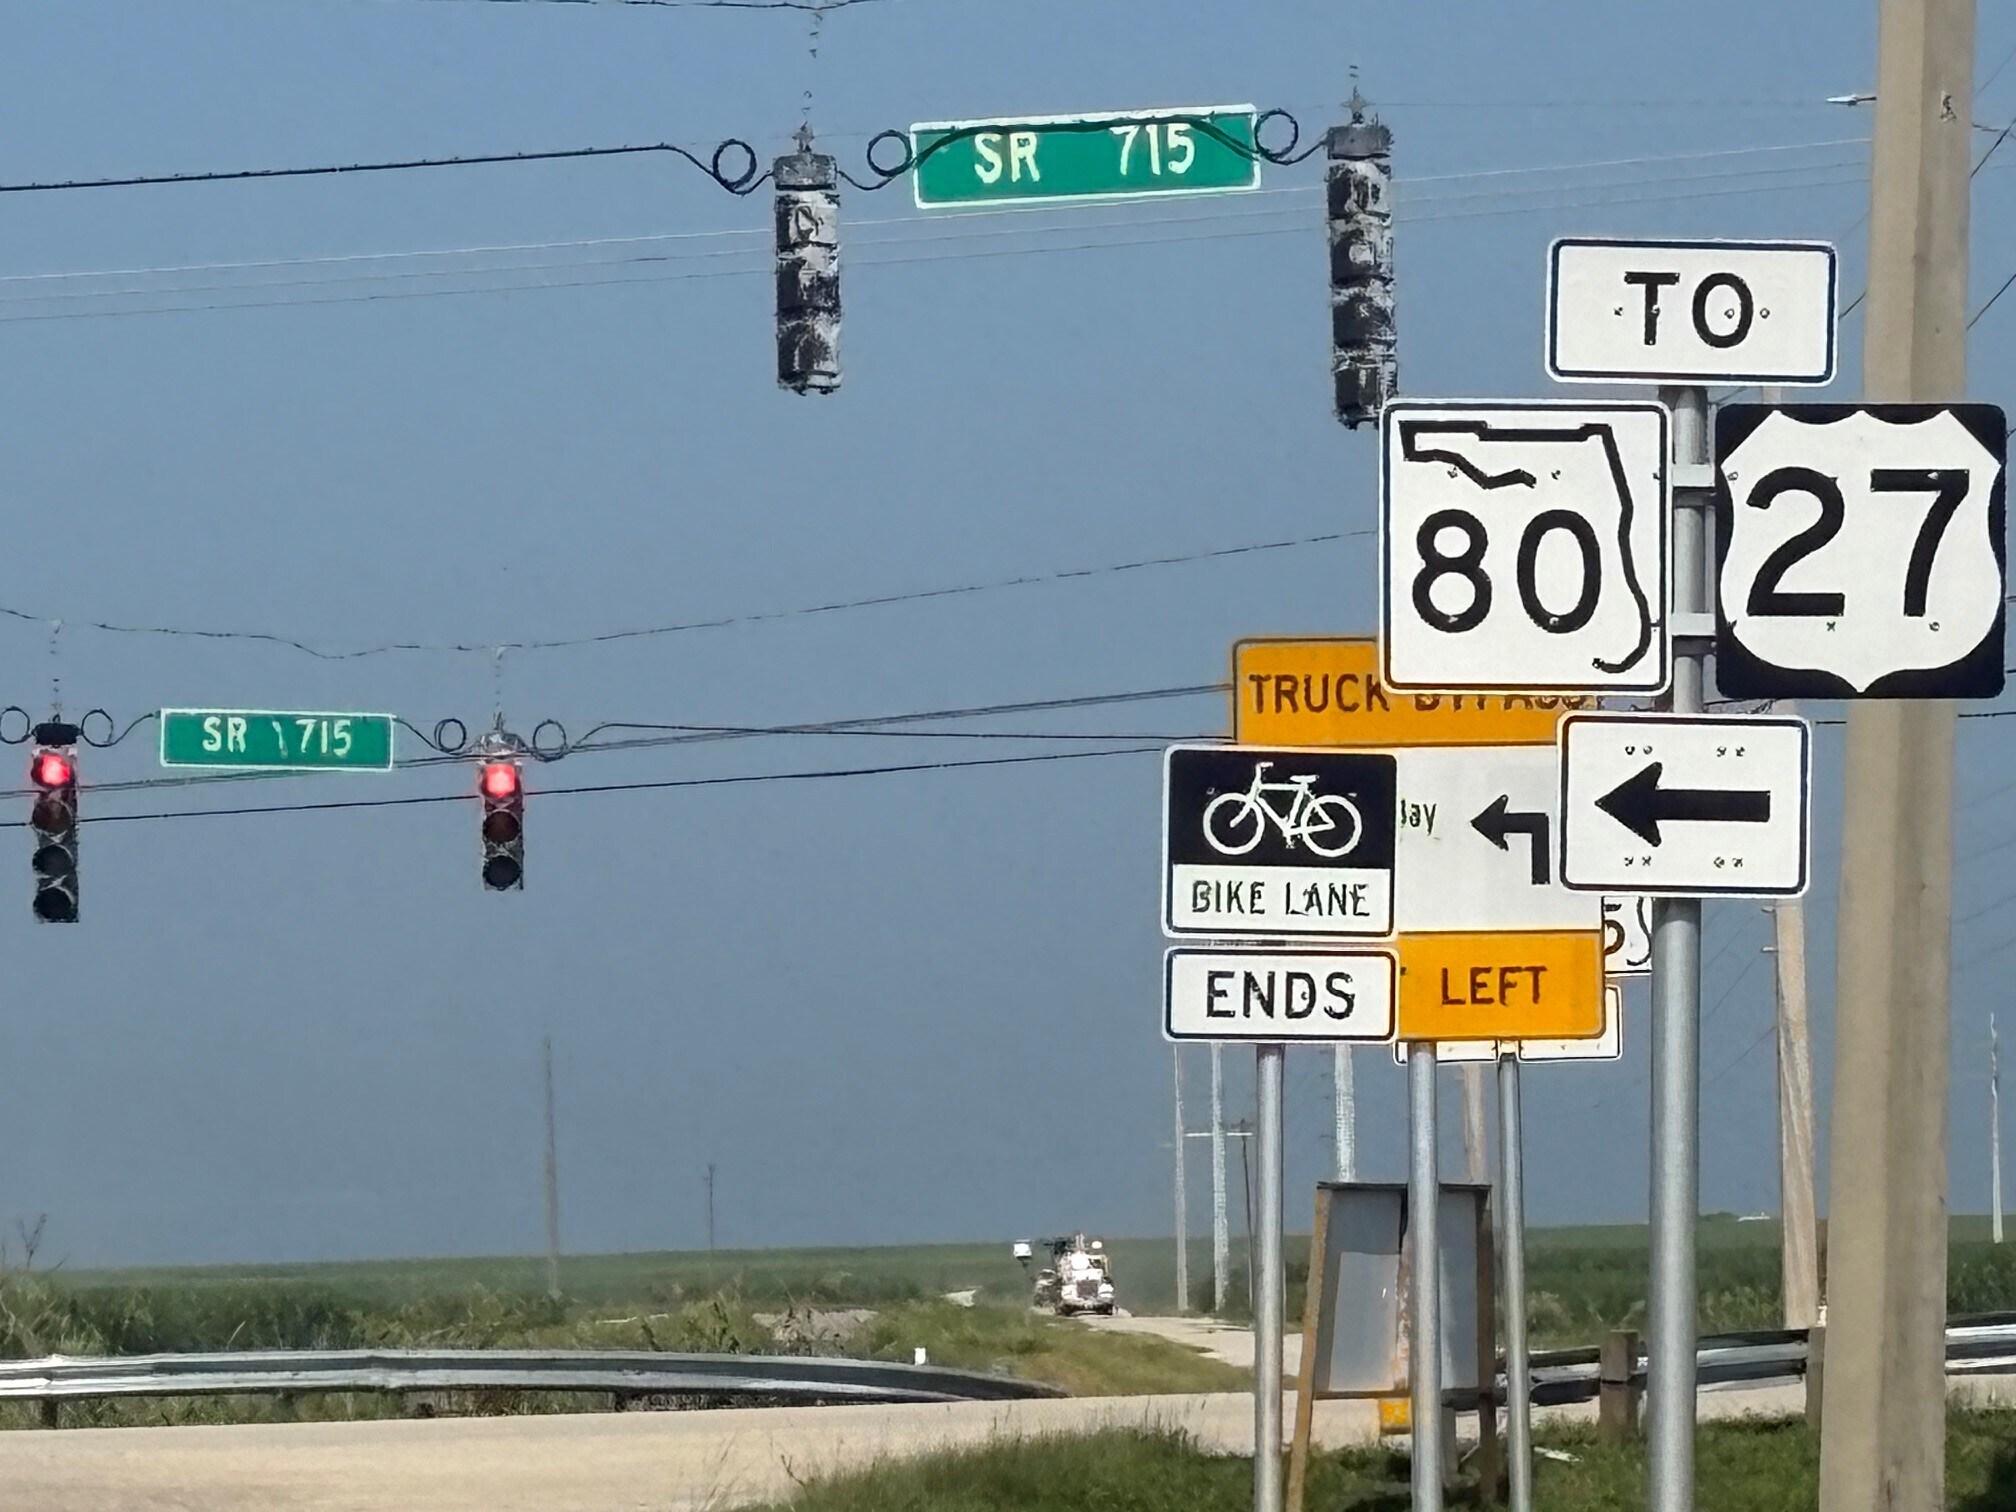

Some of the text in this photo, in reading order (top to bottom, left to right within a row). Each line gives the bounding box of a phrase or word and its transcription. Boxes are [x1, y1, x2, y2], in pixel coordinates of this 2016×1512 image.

[974, 123, 1196, 184] SR 715
[1624, 271, 1754, 348] TO
[1746, 466, 1970, 617] 27
[1411, 509, 1602, 634] 80
[1248, 673, 1390, 713] TRUCK
[202, 716, 352, 757] SR 715
[1192, 880, 1370, 917] BIKE LANE
[1206, 970, 1356, 1019] ENDS
[1441, 966, 1548, 1006] LEFT
